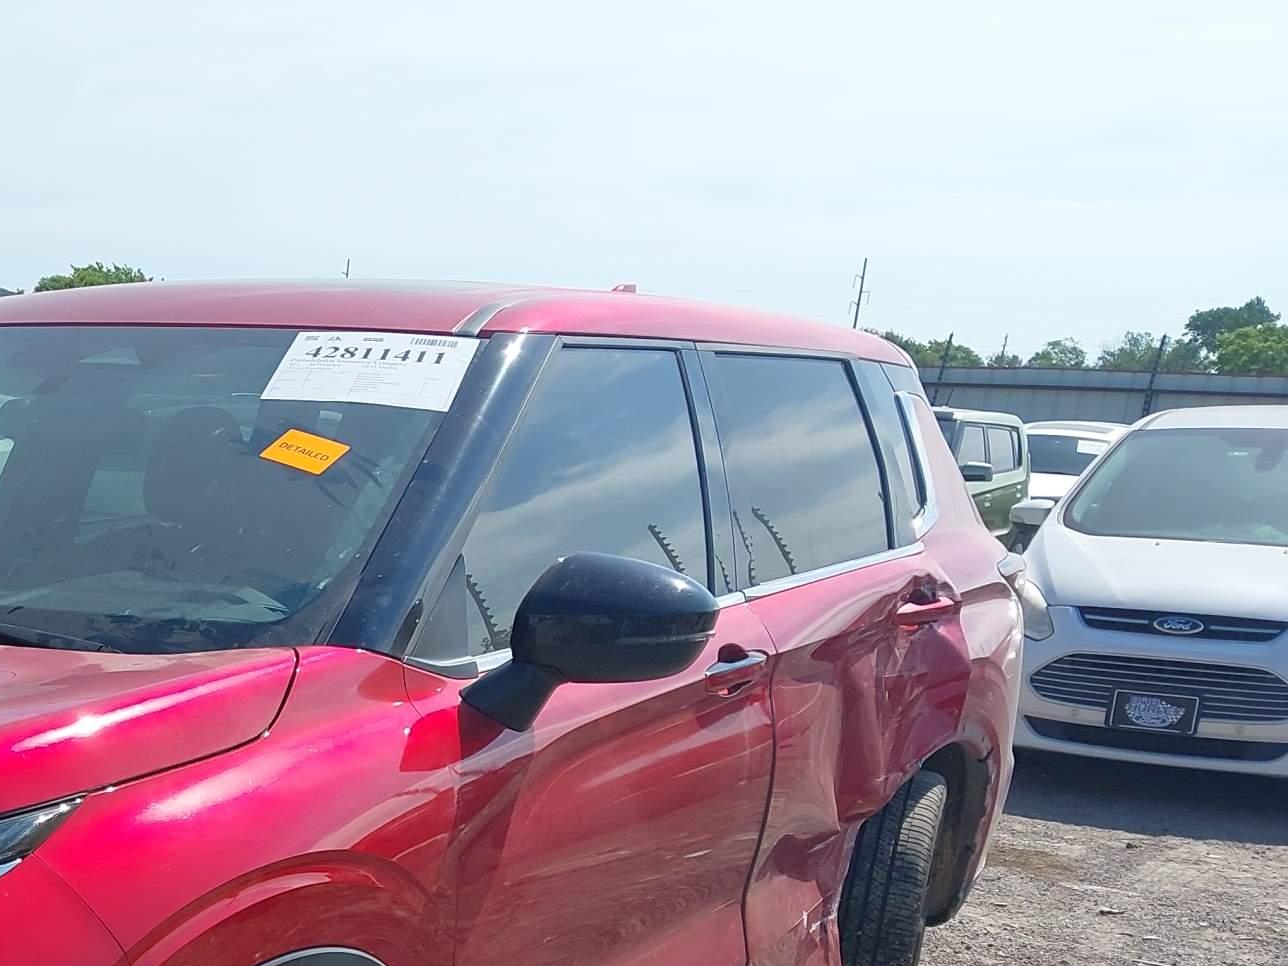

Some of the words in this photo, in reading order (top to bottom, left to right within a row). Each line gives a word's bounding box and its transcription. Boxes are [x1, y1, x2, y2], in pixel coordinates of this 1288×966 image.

[304, 346, 446, 365] 42811411
[279, 441, 329, 462] DETAILED
[1162, 617, 1193, 631] Ford
